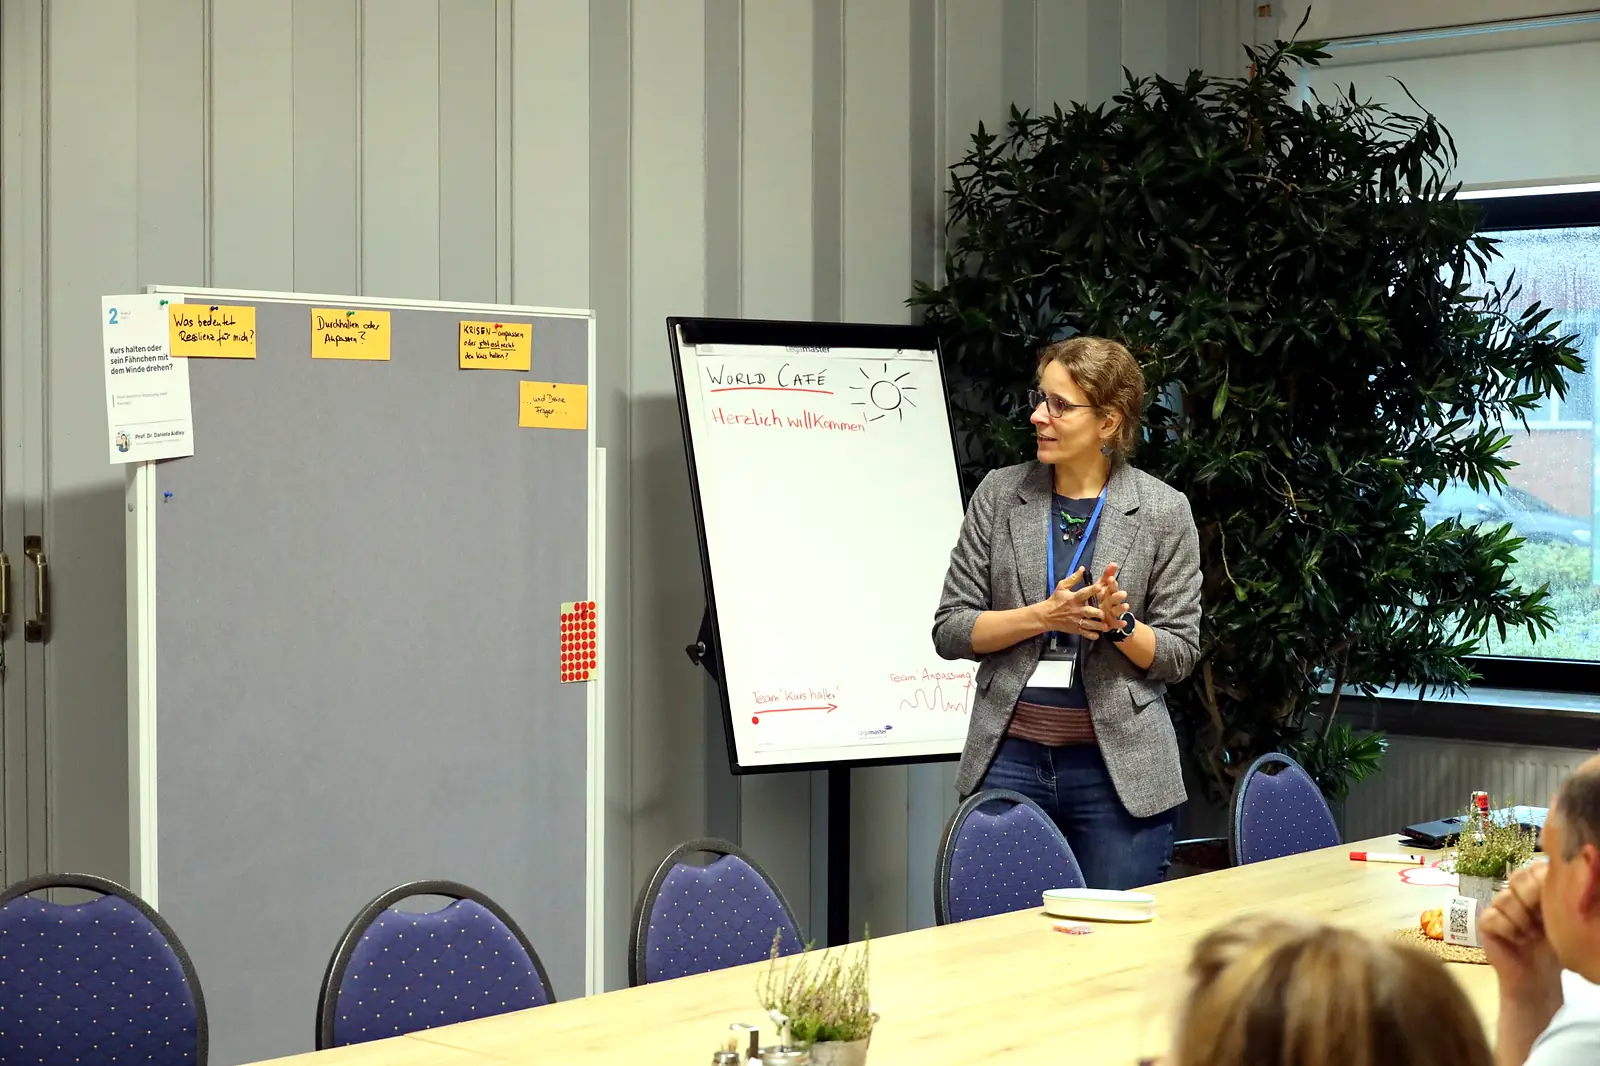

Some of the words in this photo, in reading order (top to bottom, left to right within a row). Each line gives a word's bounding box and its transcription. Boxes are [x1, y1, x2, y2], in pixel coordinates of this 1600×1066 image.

[109, 307, 119, 324] 2
[173, 313, 194, 327] Was
[198, 313, 236, 327] bedeutet
[317, 315, 359, 331] Durchhalten
[363, 320, 380, 330] oder
[217, 329, 230, 346] für
[233, 329, 254, 345] mich?
[110, 346, 124, 354] Kurs
[125, 345, 147, 353] halten
[147, 344, 162, 352] oder
[110, 356, 124, 365] sein
[124, 354, 157, 363] Fähnchen
[157, 353, 169, 361] mit
[110, 367, 125, 375] dem
[125, 365, 146, 373] Winde
[146, 363, 173, 372] drehen?
[711, 407, 783, 428] Herzlich
